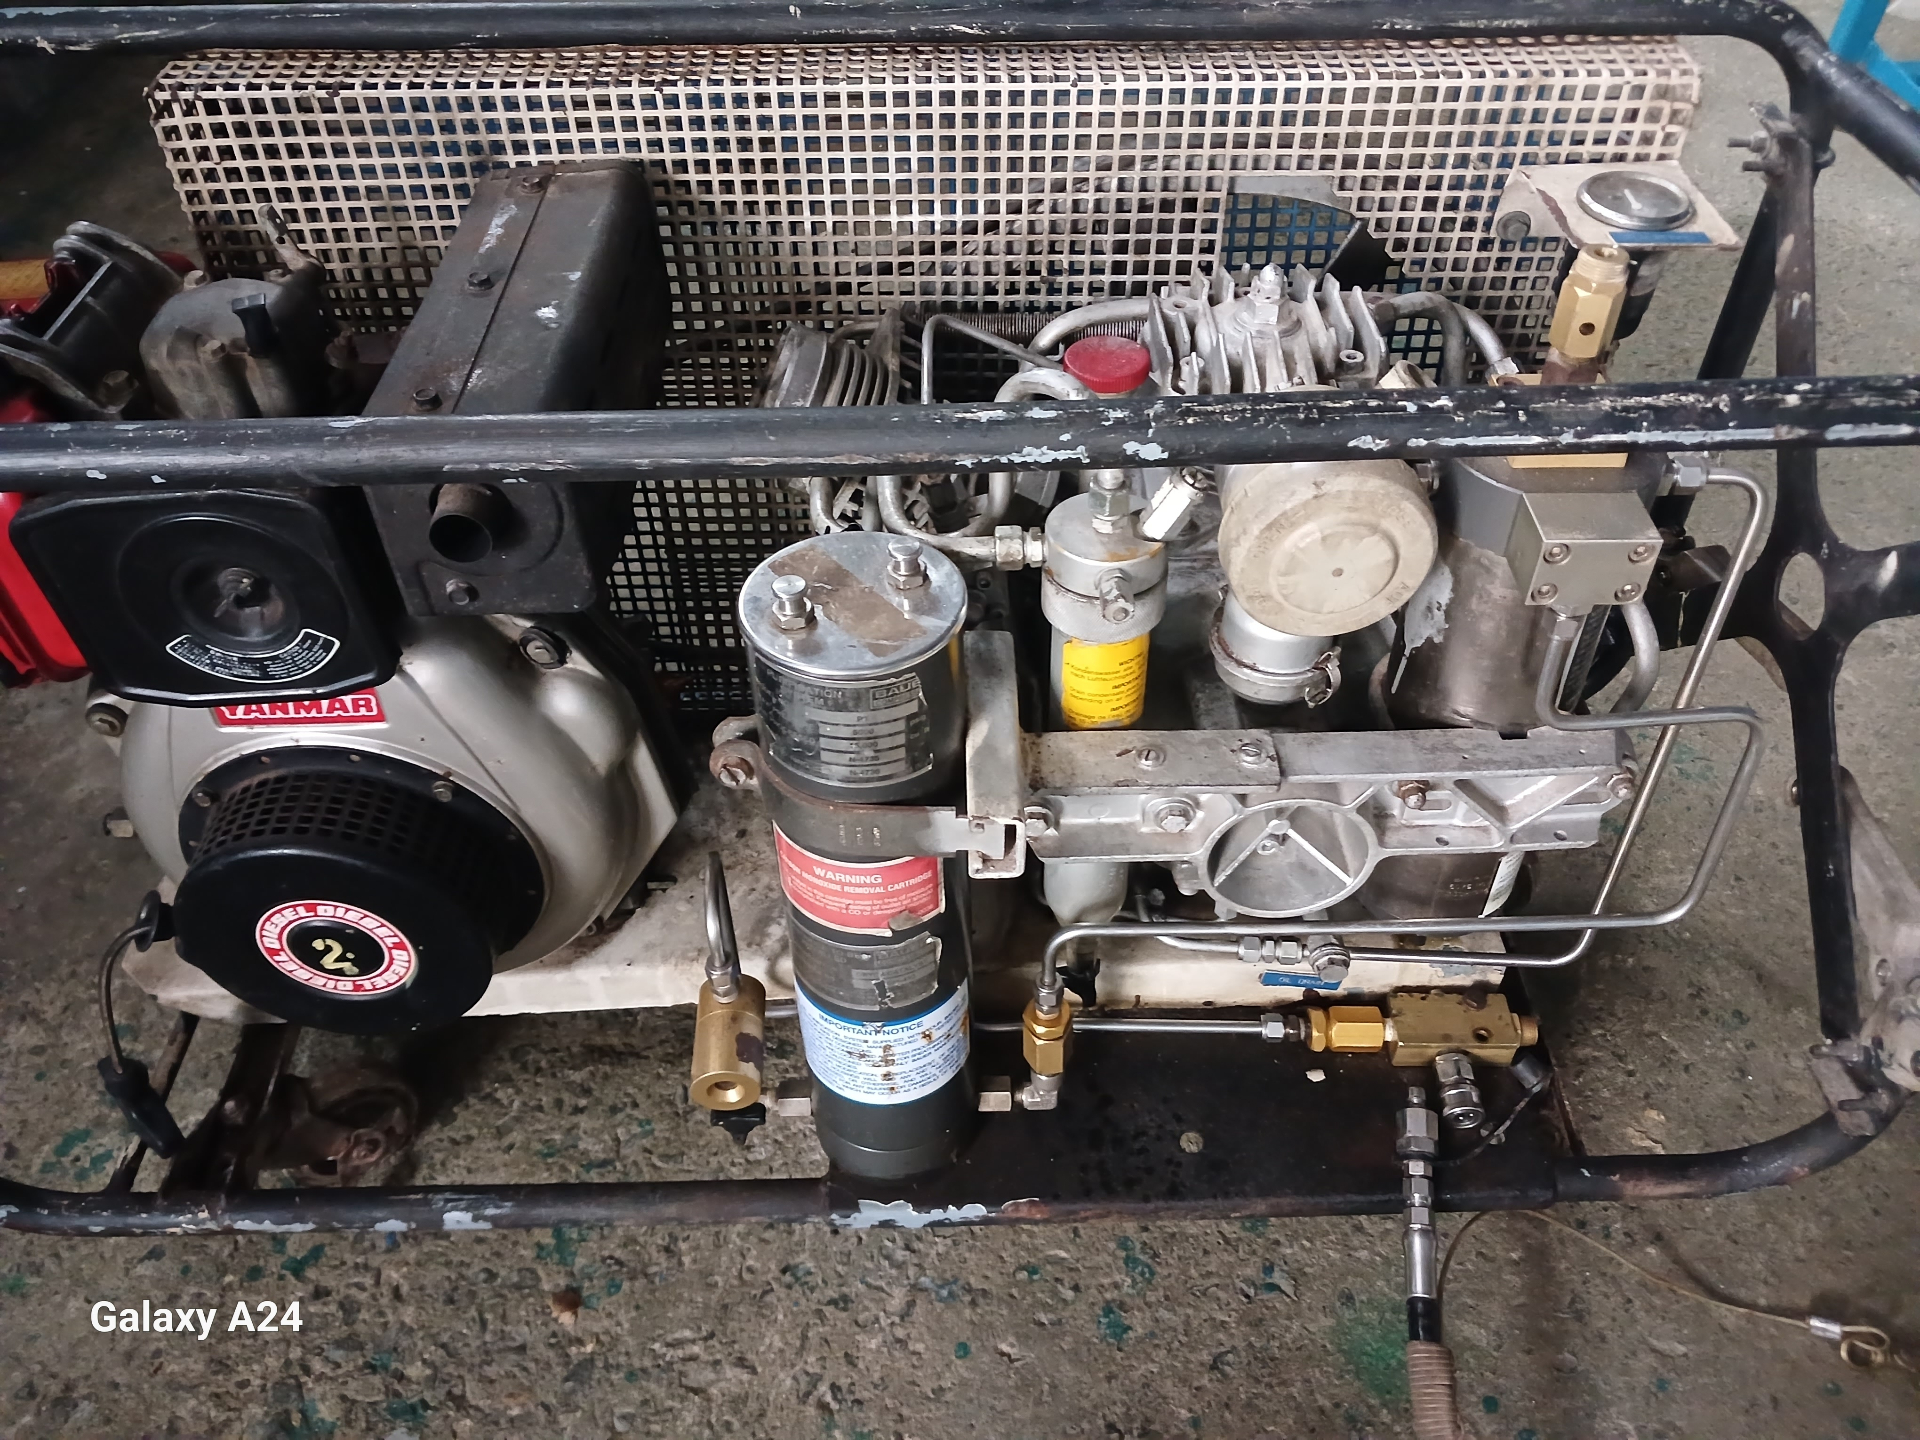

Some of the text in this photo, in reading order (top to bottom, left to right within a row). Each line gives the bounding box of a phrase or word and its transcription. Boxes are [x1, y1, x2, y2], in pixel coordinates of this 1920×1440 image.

[221, 694, 378, 719] YANMAR
[802, 871, 842, 891] MONOXIDE
[844, 885, 886, 894] REMOVAL
[888, 869, 933, 892] CARTRIDGE
[813, 866, 883, 884] WARNING
[261, 905, 410, 991] DIESEL DIESEL DIESEL DIESEL
[819, 1013, 879, 1037] IMPORTANT
[882, 1020, 924, 1036] NOTICE
